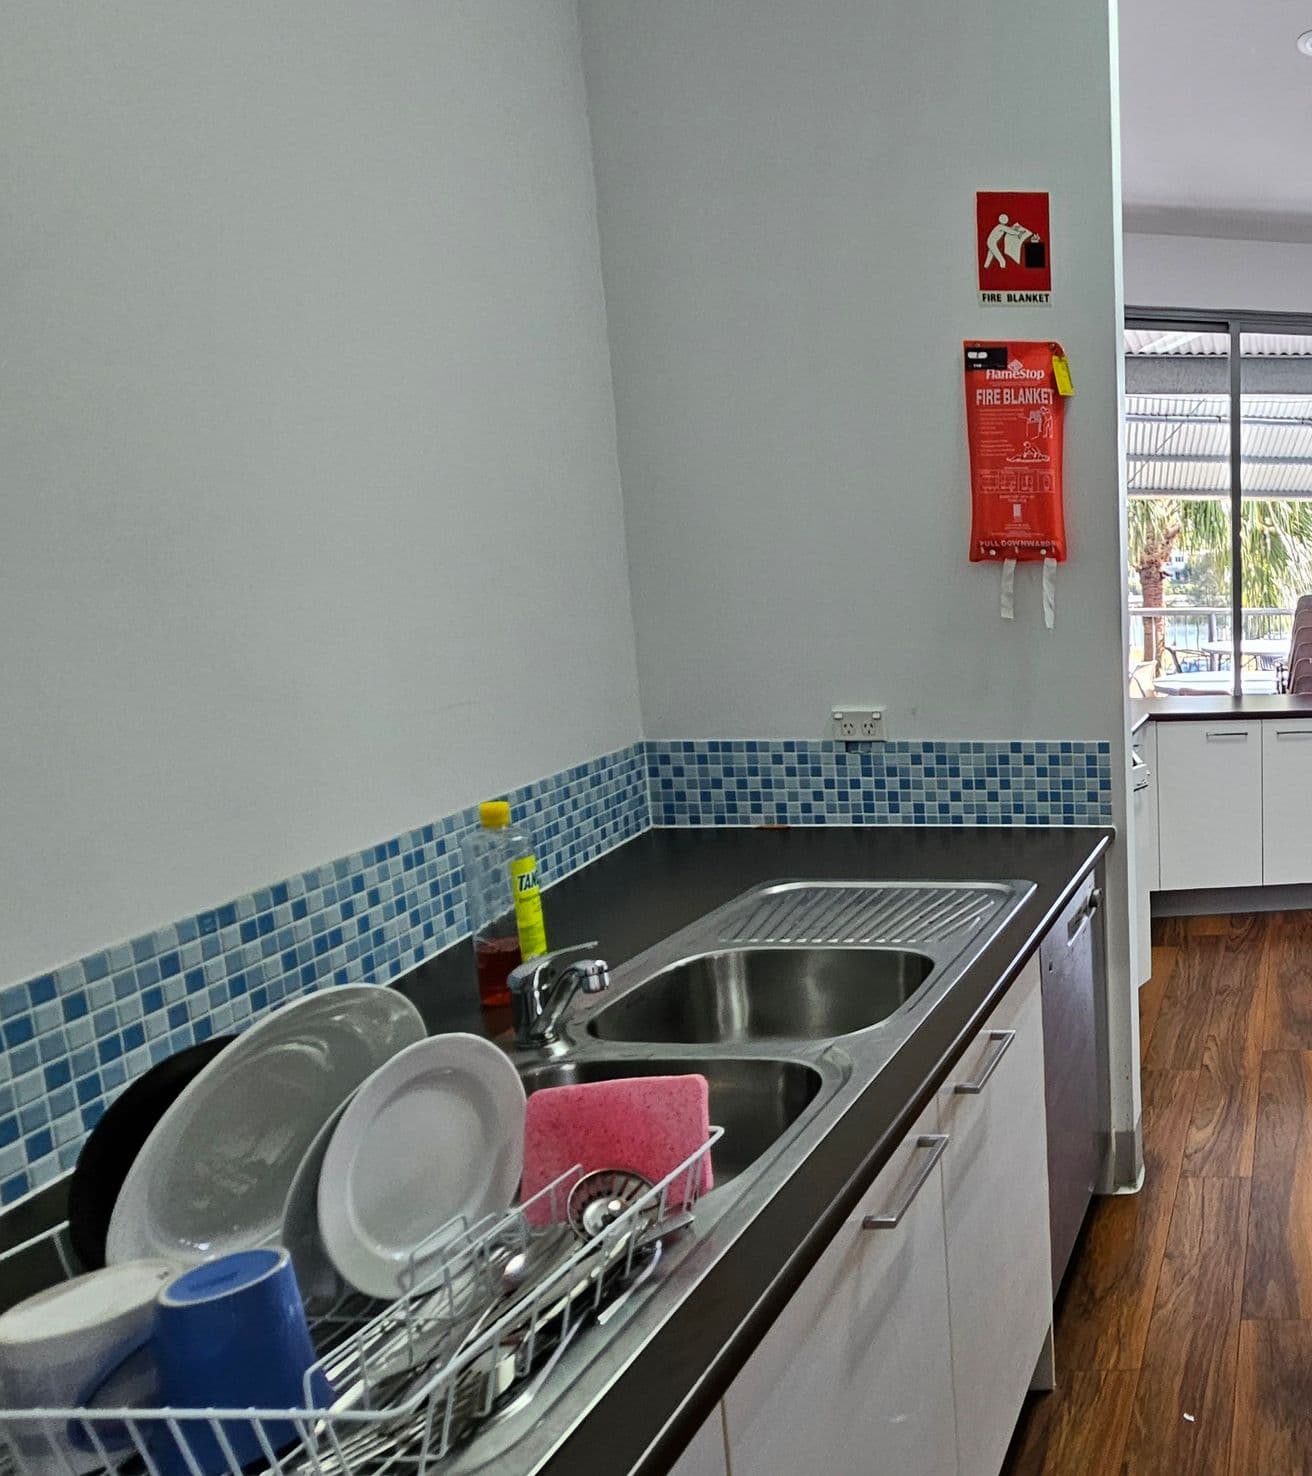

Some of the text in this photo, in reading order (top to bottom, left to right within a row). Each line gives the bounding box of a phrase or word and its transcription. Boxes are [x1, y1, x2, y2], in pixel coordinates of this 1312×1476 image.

[982, 293, 1050, 303] FIRE BLANKET
[985, 368, 1046, 381] FlameStop
[976, 388, 1055, 405] FIRE BLANKET
